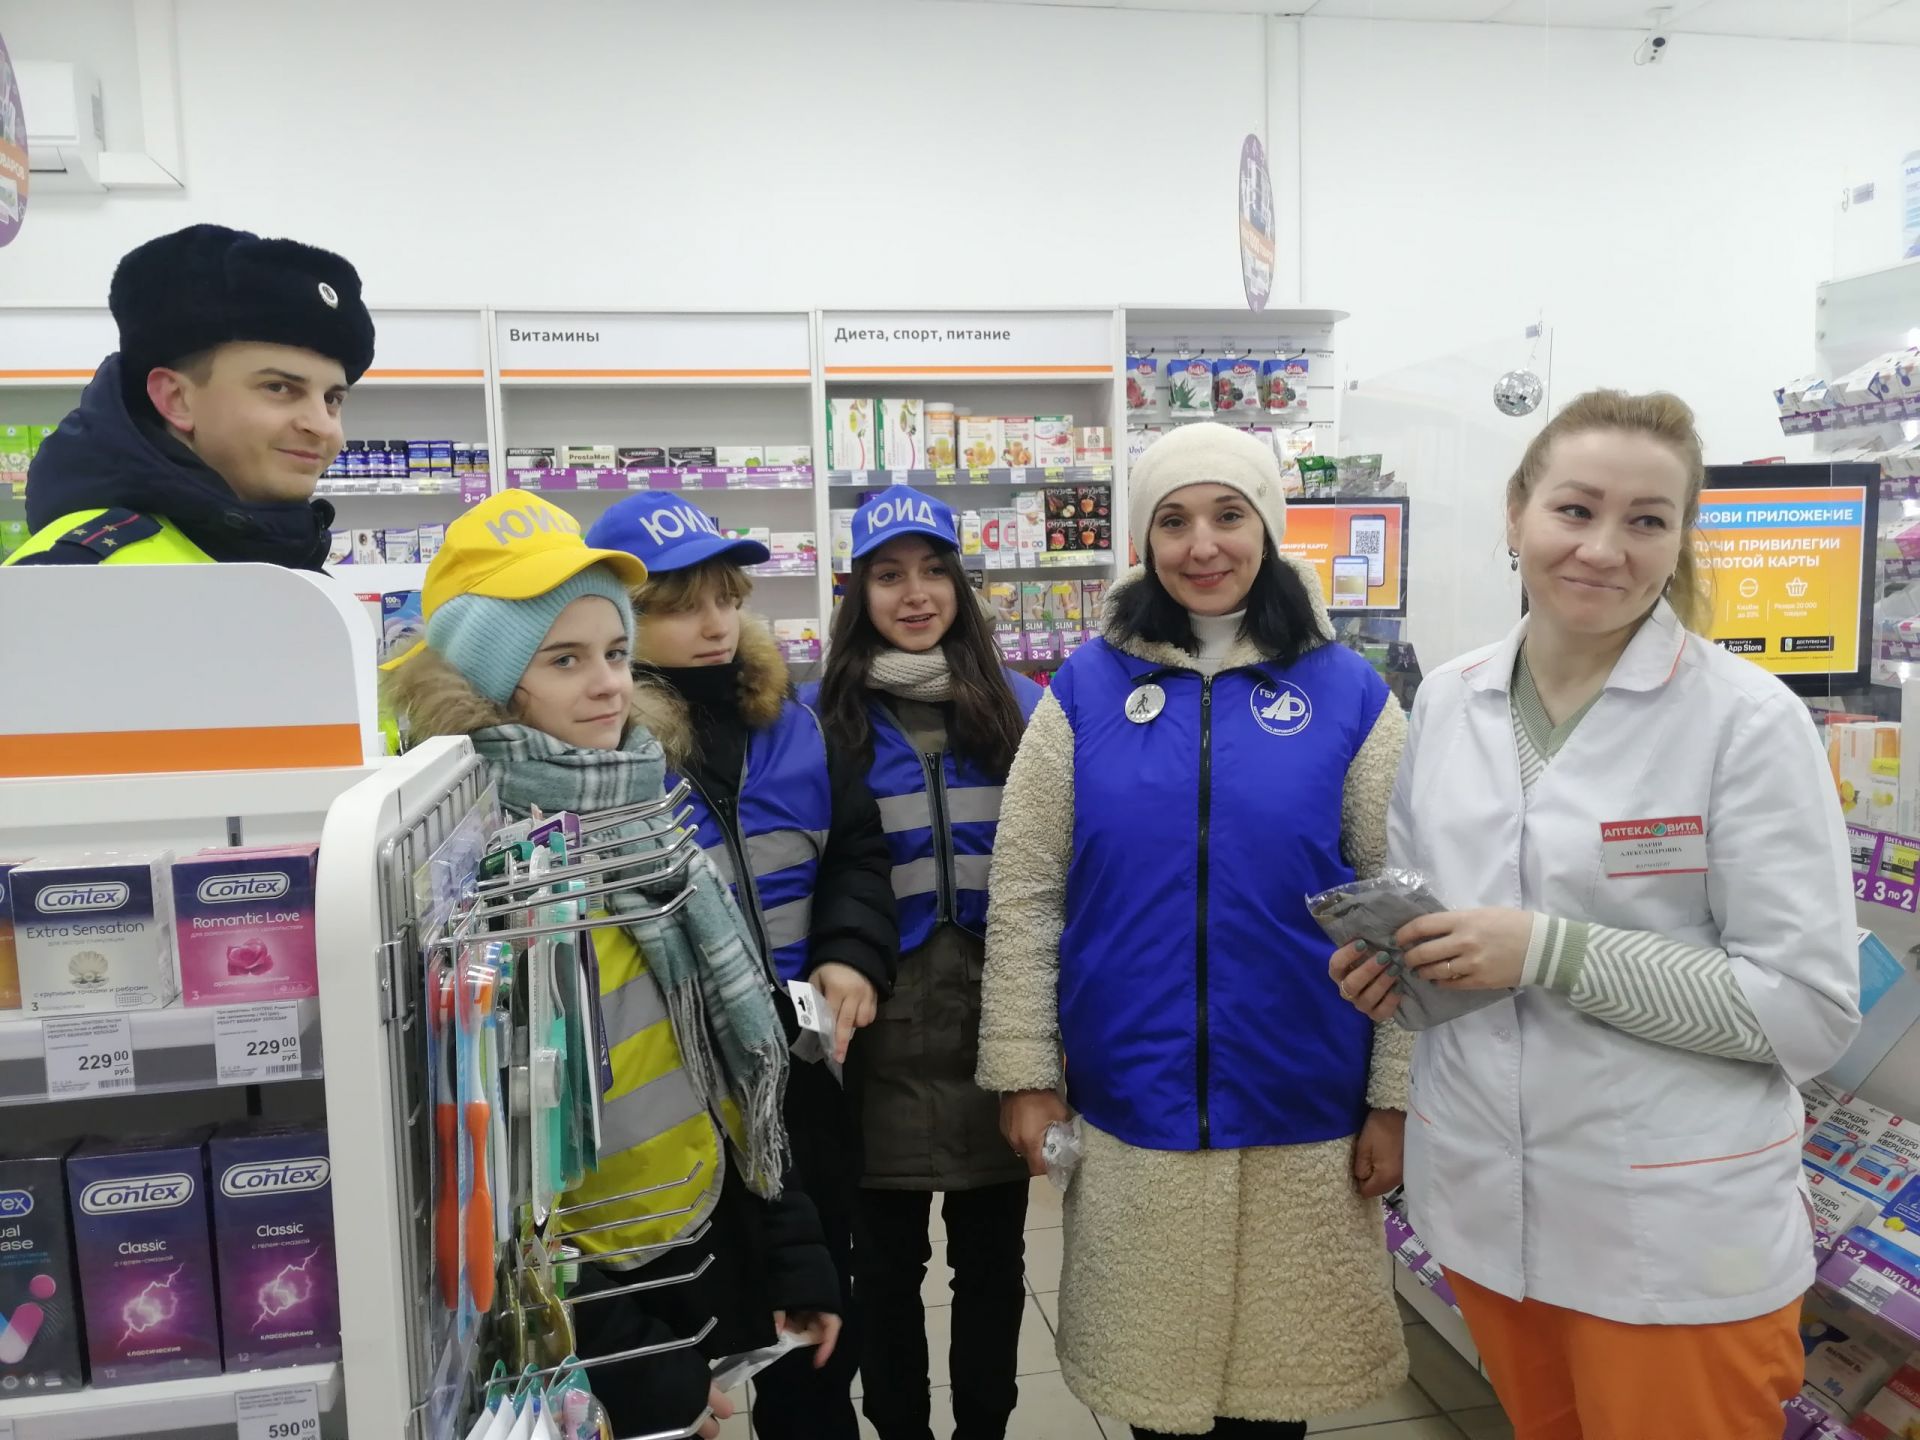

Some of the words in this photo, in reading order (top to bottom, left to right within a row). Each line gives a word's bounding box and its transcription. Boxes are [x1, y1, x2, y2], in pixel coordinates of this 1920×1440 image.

[509, 329, 600, 343] Витамины
[834, 327, 889, 343] Диета,
[893, 328, 943, 344] спорт,
[946, 329, 1011, 341] питание
[464, 493, 471, 503] 3
[867, 498, 937, 536] ЮИД
[1746, 509, 1854, 523] ПРИЛОЖЕНИЕ
[1739, 537, 1841, 551] ПРИВИЛЕГИИ
[1768, 555, 1820, 568] КАРТЫ
[1025, 623, 1043, 631] SLIM
[1055, 622, 1073, 630] SLIM
[1016, 651, 1022, 661] 2
[1032, 650, 1039, 659] 3
[1045, 650, 1052, 660] 2
[1728, 644, 1743, 653] App
[1743, 643, 1762, 652] Store
[1260, 688, 1277, 700] ГБУ
[1603, 827, 1651, 838] АПТЕКА
[1667, 822, 1699, 833] ВИТА
[205, 878, 282, 897] Contex
[1855, 878, 1867, 899] 2
[1873, 881, 1886, 901] 3
[1888, 890, 1900, 901] по
[1900, 889, 1914, 910] 2
[44, 888, 121, 907] Contex
[192, 912, 264, 929] Romantic
[266, 911, 300, 924] Love
[26, 925, 69, 940] Extra
[72, 922, 145, 937] Sensation
[191, 990, 200, 1000] 3
[31, 1001, 39, 1012] 3
[246, 1039, 281, 1057] 229
[281, 1037, 297, 1048] 00
[78, 1053, 113, 1072] 229
[113, 1050, 129, 1062] 00
[282, 1053, 299, 1062] руб.
[114, 1066, 132, 1076] руб.
[1833, 1108, 1869, 1126] ДИГИДРО
[1828, 1114, 1871, 1137] КВЕРЦЕТИН
[1880, 1130, 1919, 1150] ДИГИДРО
[230, 1165, 323, 1190] Contex
[90, 1182, 184, 1207] Contex
[256, 1222, 304, 1238] Classic
[1392, 1216, 1399, 1225] 3
[1399, 1222, 1407, 1231] 2
[118, 1239, 167, 1255] Classic
[1837, 1239, 1850, 1252] 3
[1853, 1250, 1867, 1263] 2
[1881, 1266, 1910, 1289] ВИТА
[238, 1353, 250, 1363] 12
[104, 1369, 117, 1379] 12
[1790, 1396, 1803, 1408] 3
[1805, 1408, 1818, 1420] 2
[268, 1422, 301, 1439] 590
[301, 1418, 316, 1429] 00
